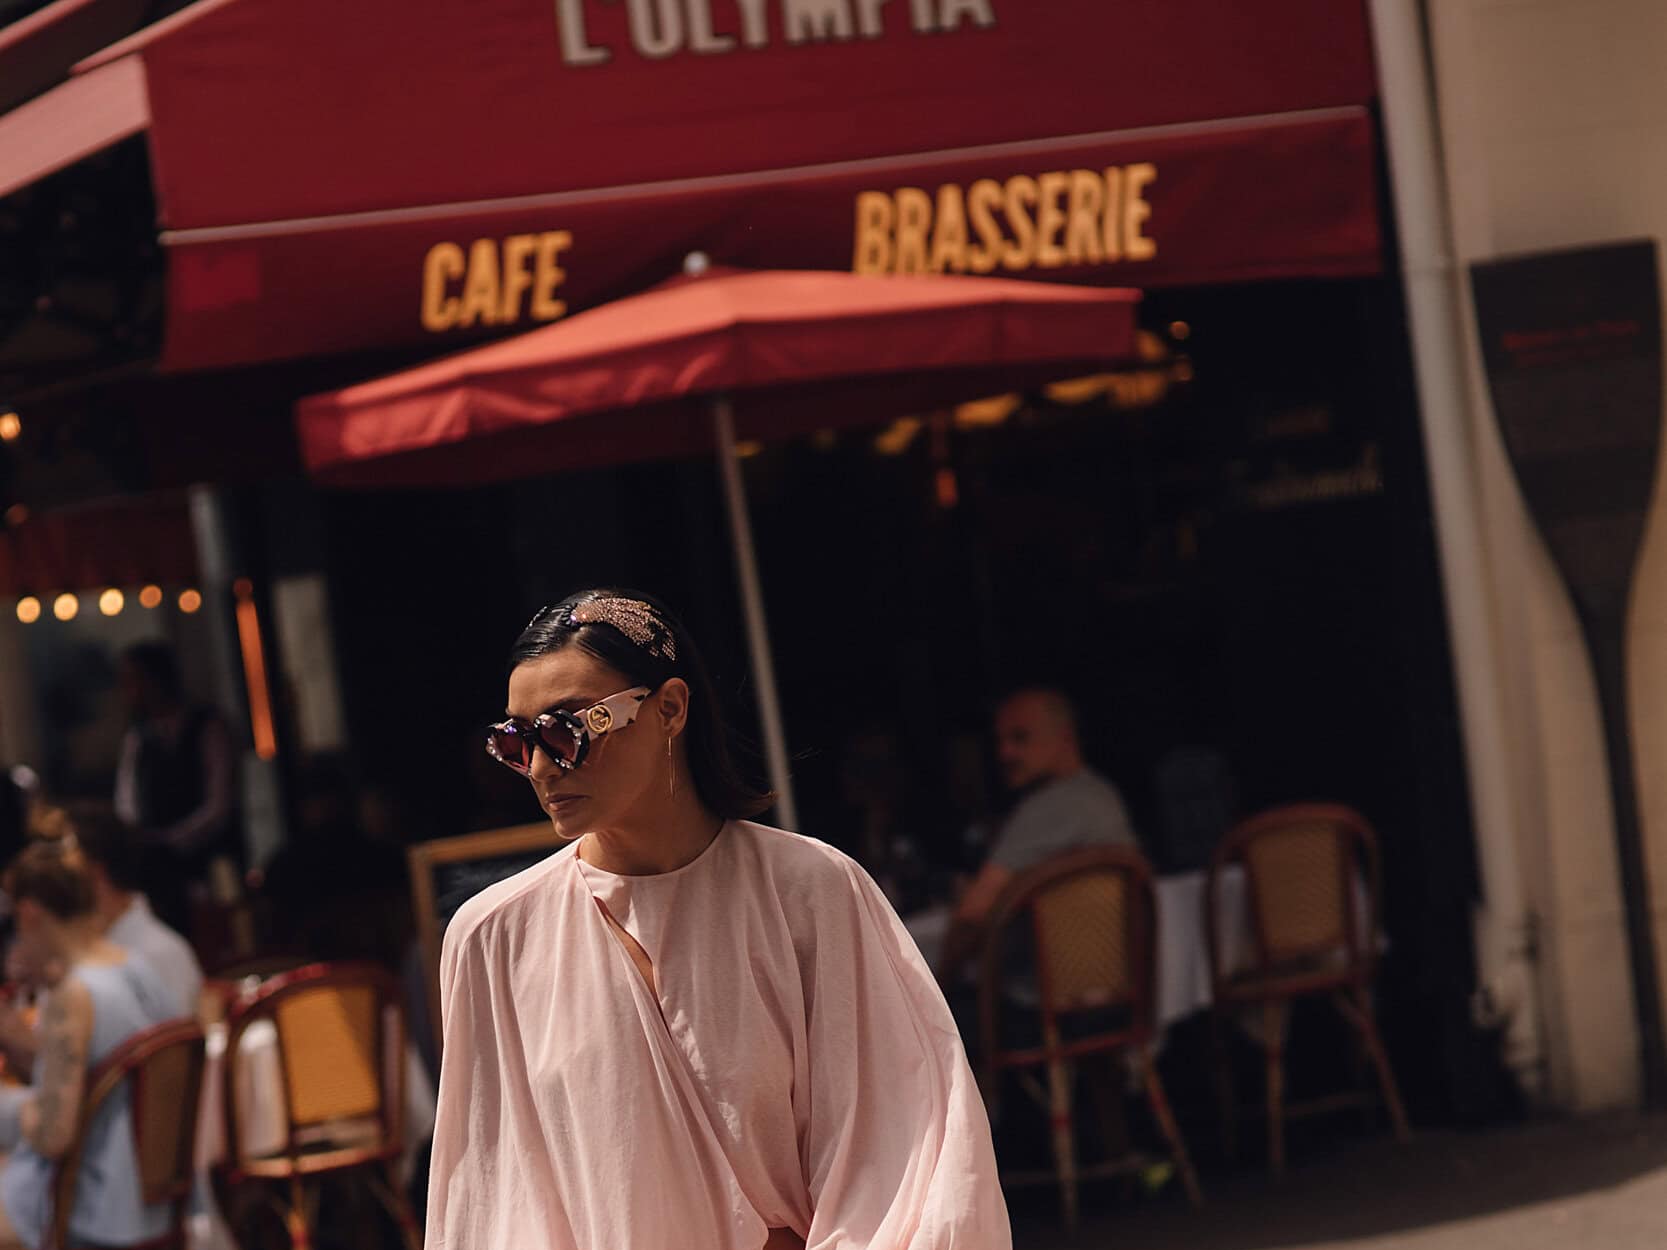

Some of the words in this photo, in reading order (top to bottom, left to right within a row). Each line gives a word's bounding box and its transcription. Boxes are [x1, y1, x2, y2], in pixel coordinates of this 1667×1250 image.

[557, 0, 997, 67] LOLYM
[421, 229, 572, 332] CAFE
[854, 162, 1157, 276] BRASSERIE
